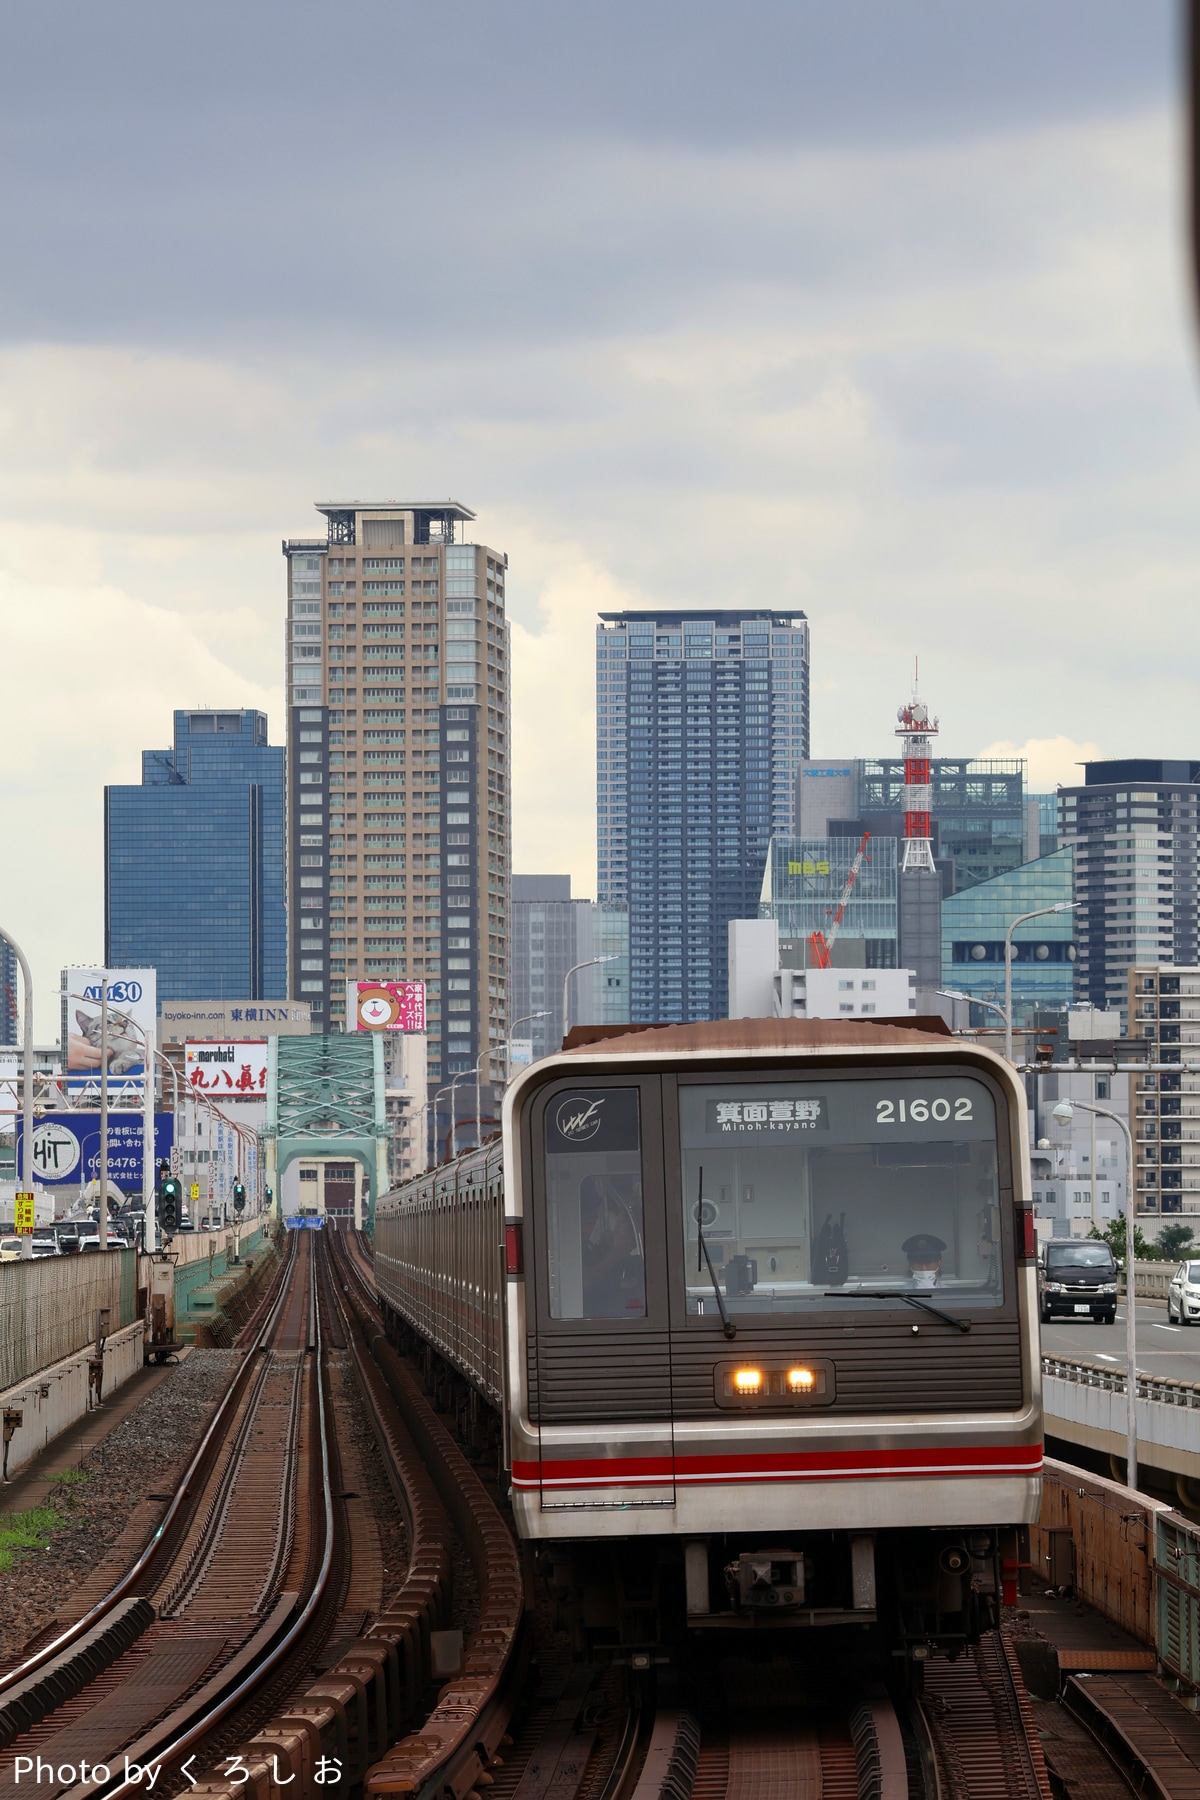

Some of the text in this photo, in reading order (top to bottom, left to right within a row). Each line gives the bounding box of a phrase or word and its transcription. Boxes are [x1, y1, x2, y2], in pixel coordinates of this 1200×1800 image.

[165, 1011, 225, 1022] toyoko-inn.com
[414, 984, 423, 1030] 家事代行は
[199, 1046, 235, 1063] maruhati
[716, 1100, 821, 1123] 箕面萱野
[876, 1098, 973, 1123] 21602
[722, 1121, 816, 1132] Minoh-kayano
